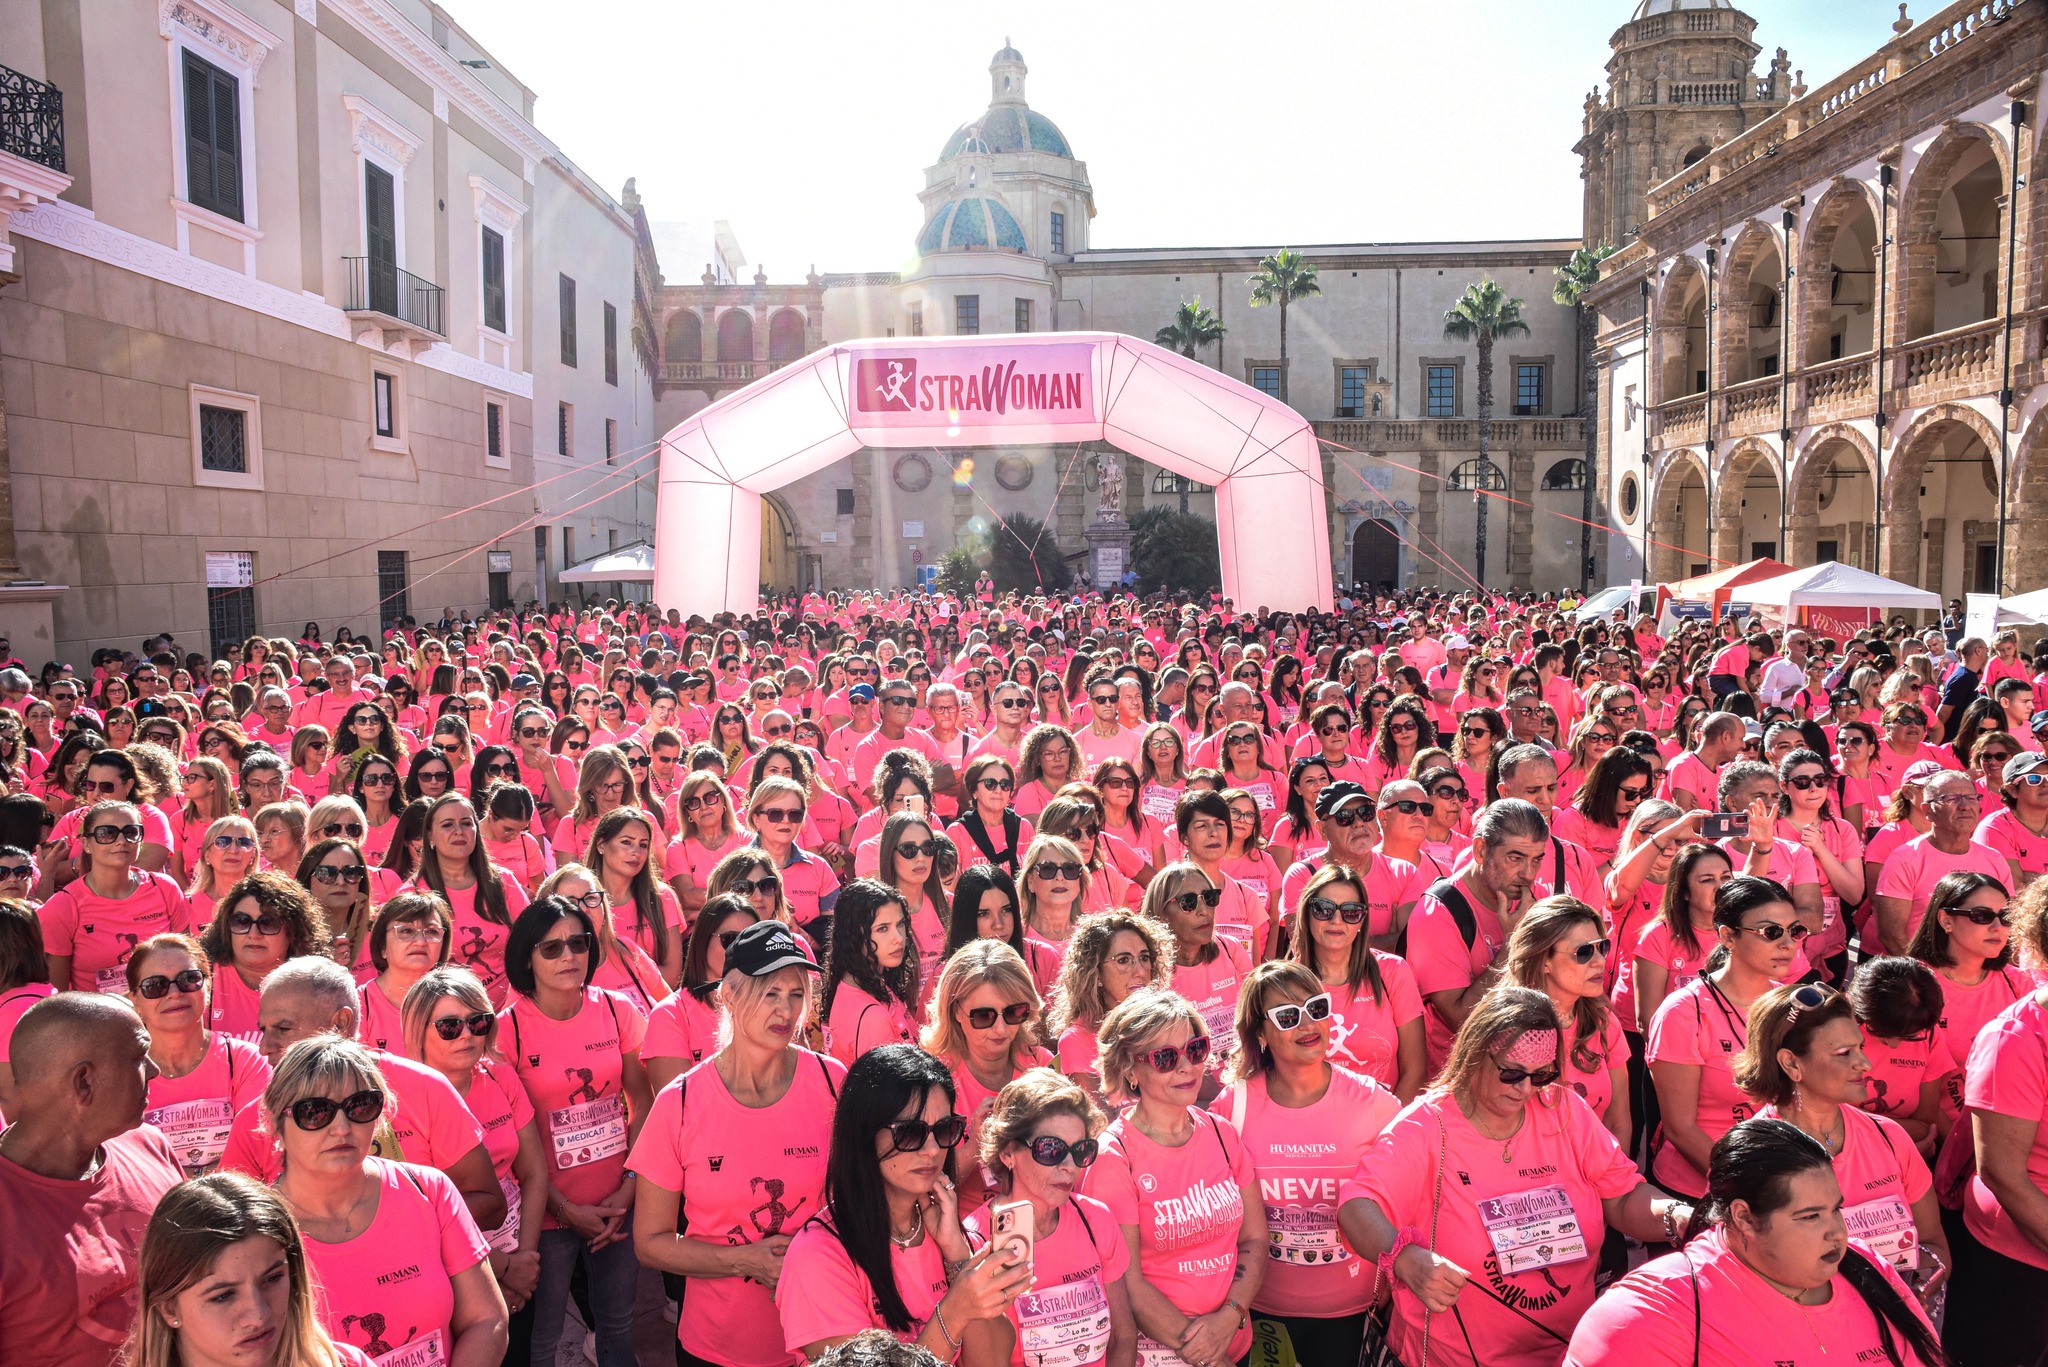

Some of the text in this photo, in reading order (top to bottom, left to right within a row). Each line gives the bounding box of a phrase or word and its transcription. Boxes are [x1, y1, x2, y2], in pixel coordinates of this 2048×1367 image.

[920, 360, 1082, 415] STRAWOMAN
[164, 1104, 219, 1124] STRAWOMAN
[483, 1113, 514, 1131] UMANITAS
[1270, 1143, 1337, 1154] HUMANITAS
[1260, 1178, 1342, 1201] NEVE
[1505, 1194, 1557, 1218] STRAWOMAN
[1284, 1211, 1337, 1225] STRAWOMA
[377, 1265, 420, 1285] HUMANI
[1062, 1264, 1101, 1284] HUMANITAS
[1044, 1288, 1096, 1314] STRAWOMAN
[1024, 1318, 1045, 1326] MAZARA
[1057, 1311, 1073, 1319] VALLO
[1054, 1317, 1092, 1330] POLIAMBULATORIO
